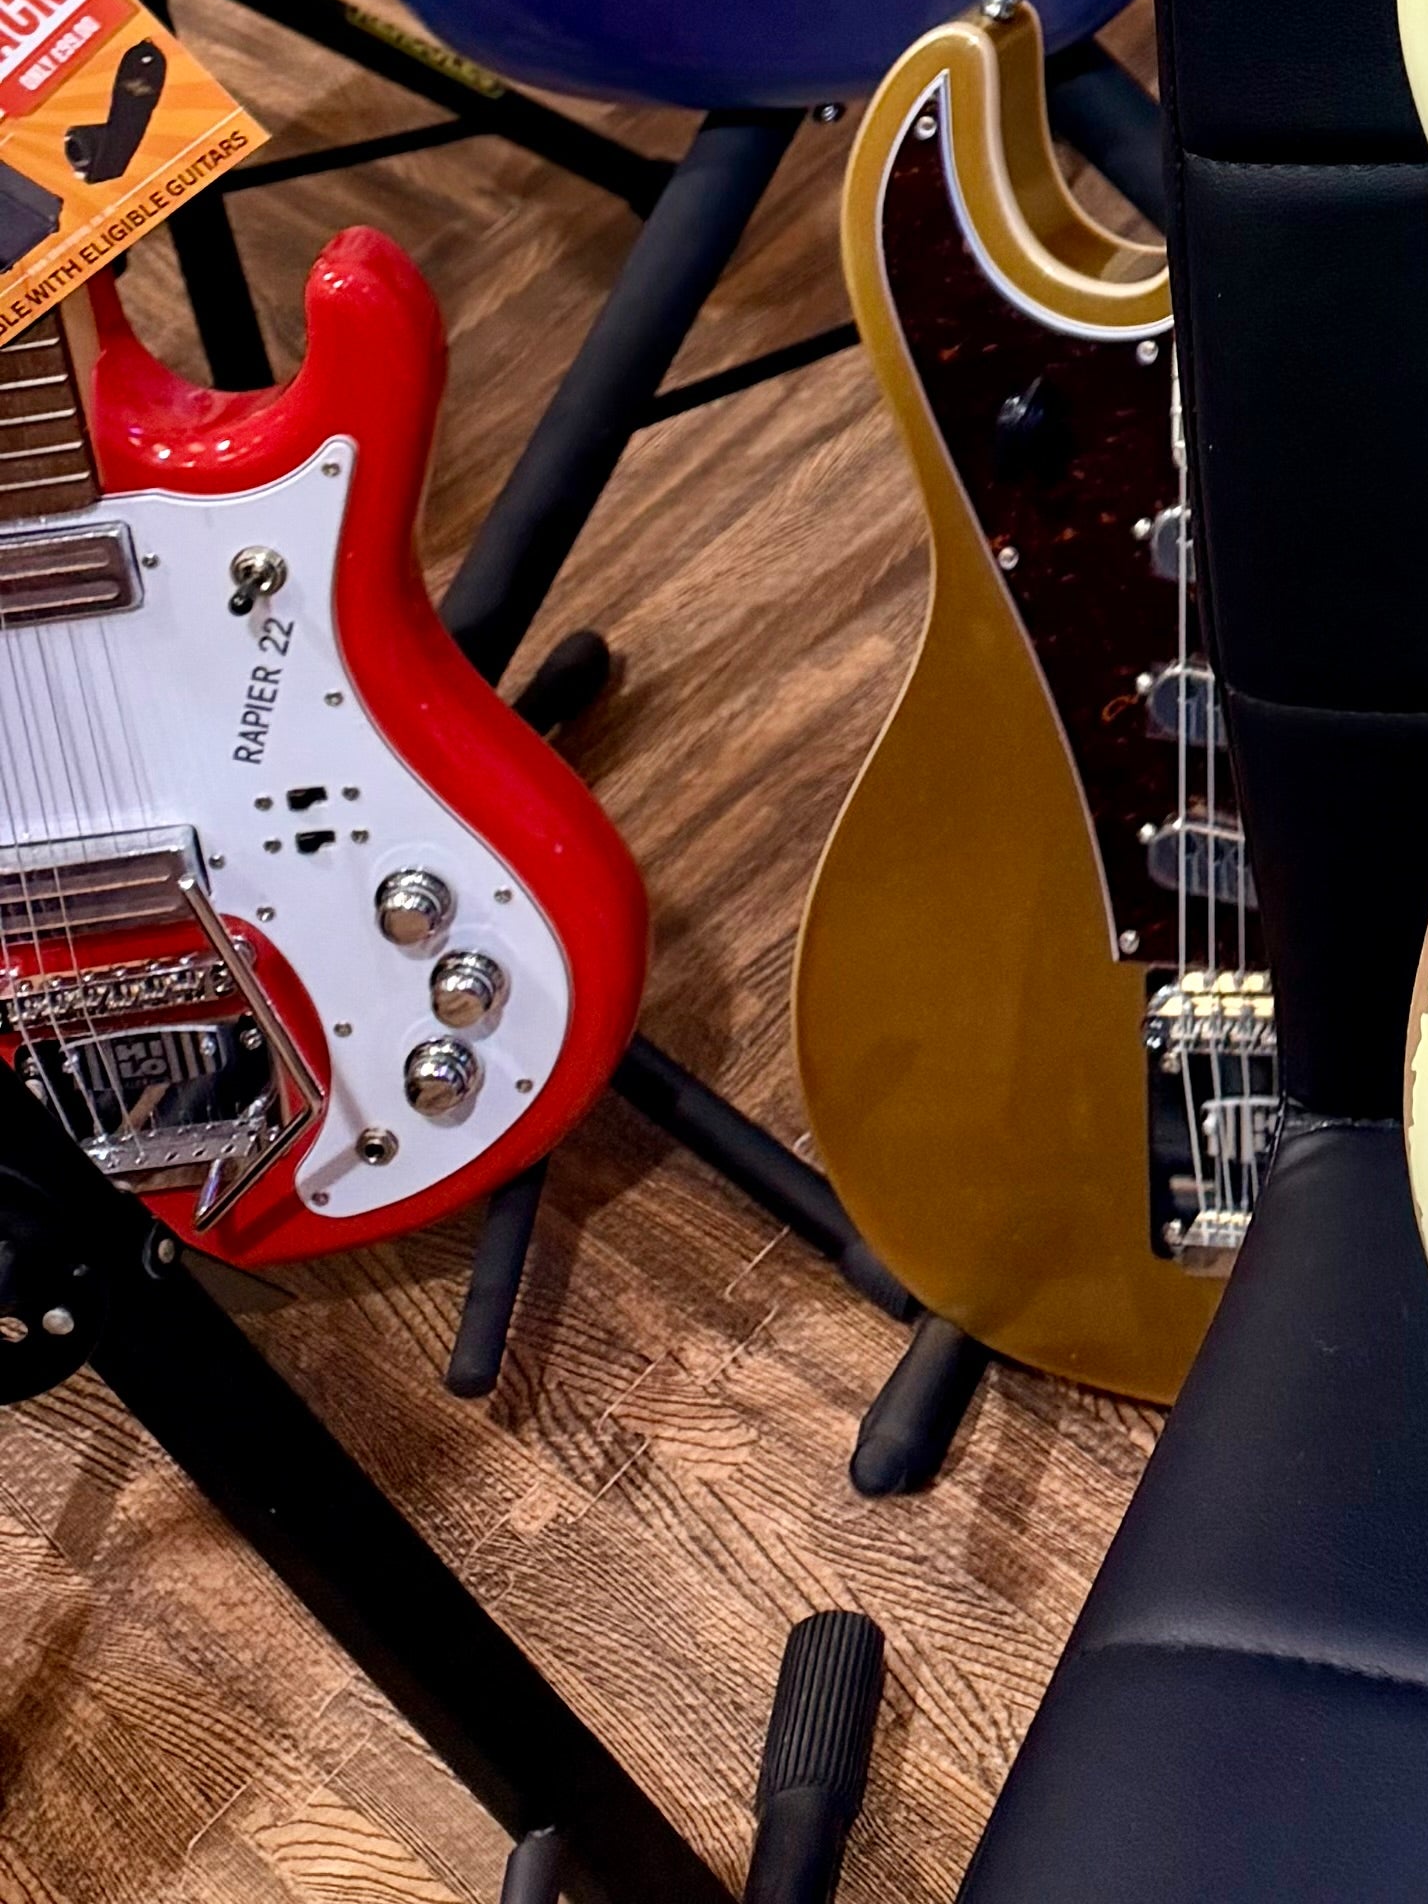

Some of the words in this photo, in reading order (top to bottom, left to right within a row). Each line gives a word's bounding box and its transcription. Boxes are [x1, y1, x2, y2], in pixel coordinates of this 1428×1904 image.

[25, 259, 83, 307] WITH
[79, 191, 171, 265] ELIGIBLE
[166, 130, 249, 197] GUITARS
[232, 665, 283, 765] RAPIER
[258, 617, 295, 657] 22
